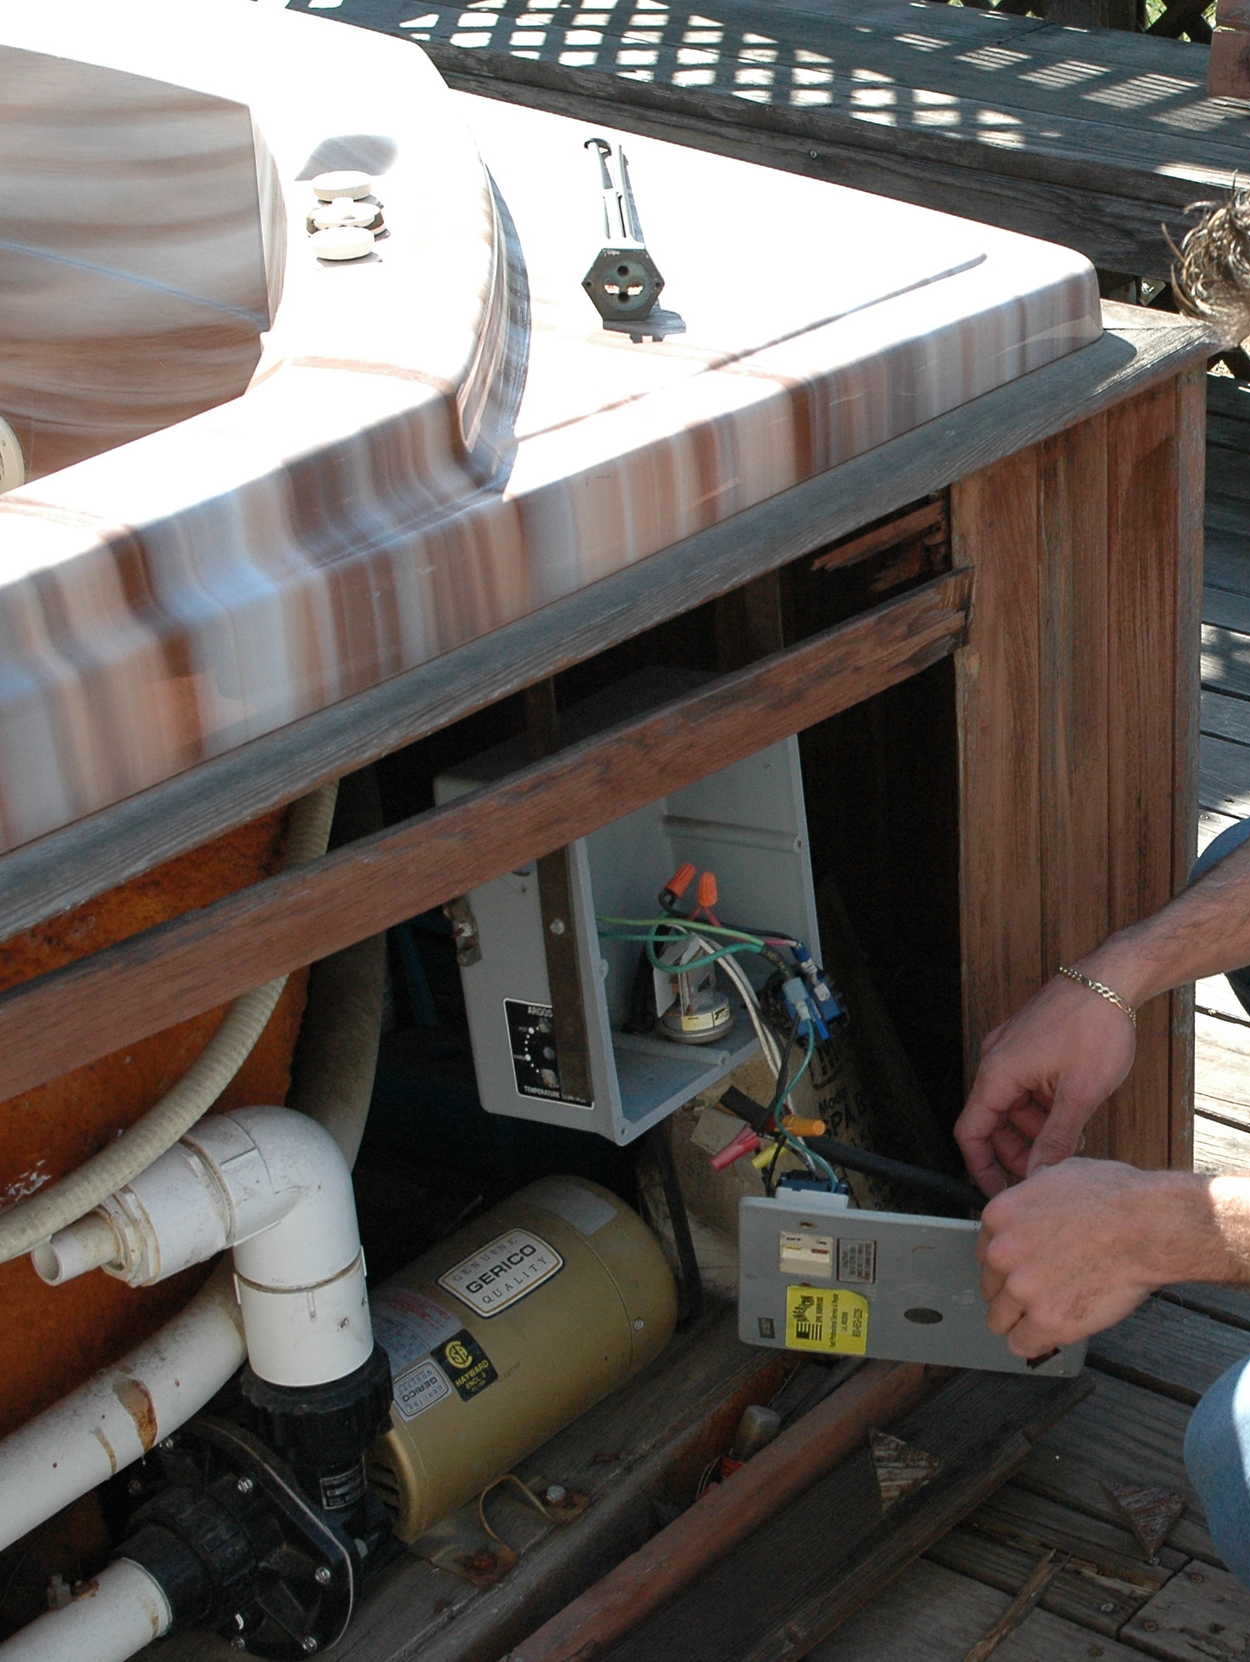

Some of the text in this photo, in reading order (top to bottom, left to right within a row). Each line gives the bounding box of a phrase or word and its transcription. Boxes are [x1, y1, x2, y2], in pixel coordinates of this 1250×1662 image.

[466, 1244, 537, 1294] GERICO
[482, 1256, 548, 1304] QUALITY
[402, 1377, 438, 1402] GERICO
[455, 1360, 489, 1386] HAYWARD
